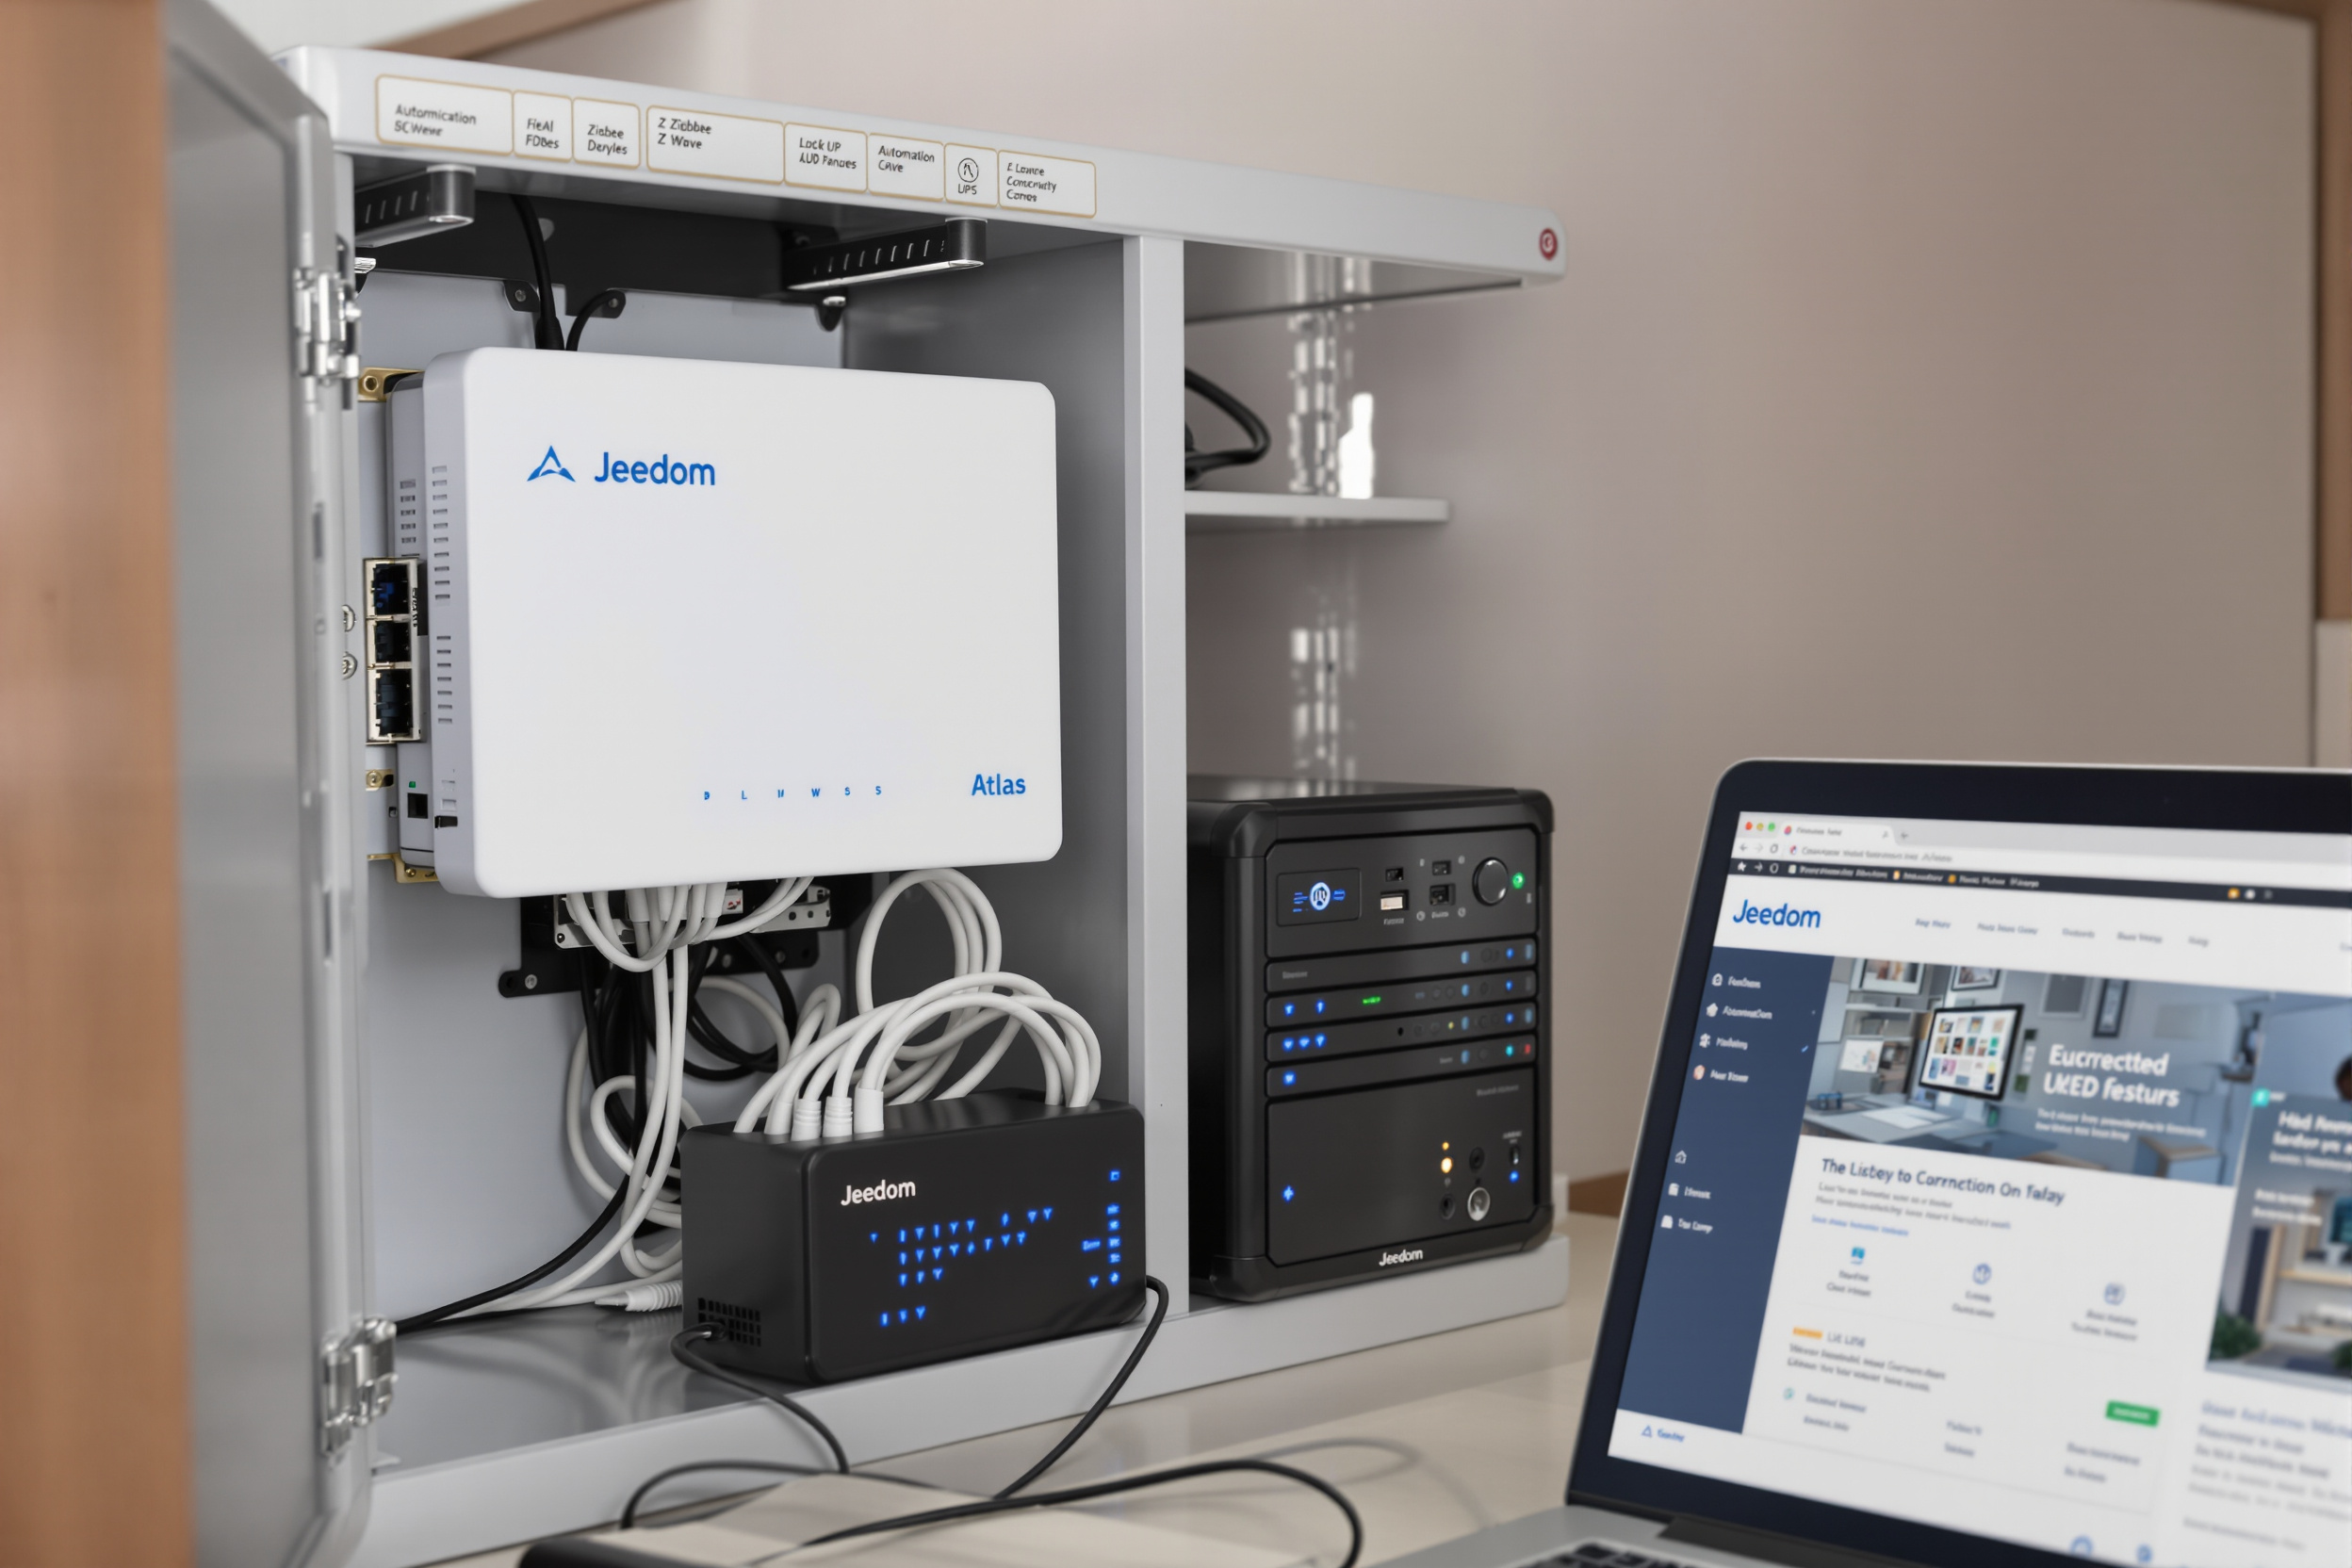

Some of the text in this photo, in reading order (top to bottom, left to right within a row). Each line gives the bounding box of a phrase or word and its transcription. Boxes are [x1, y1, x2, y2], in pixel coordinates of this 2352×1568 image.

[594, 451, 716, 486] Jeedom
[971, 773, 1026, 796] Atlas
[1732, 899, 1821, 928] Jeedom
[840, 1179, 916, 1206] Jeedom
